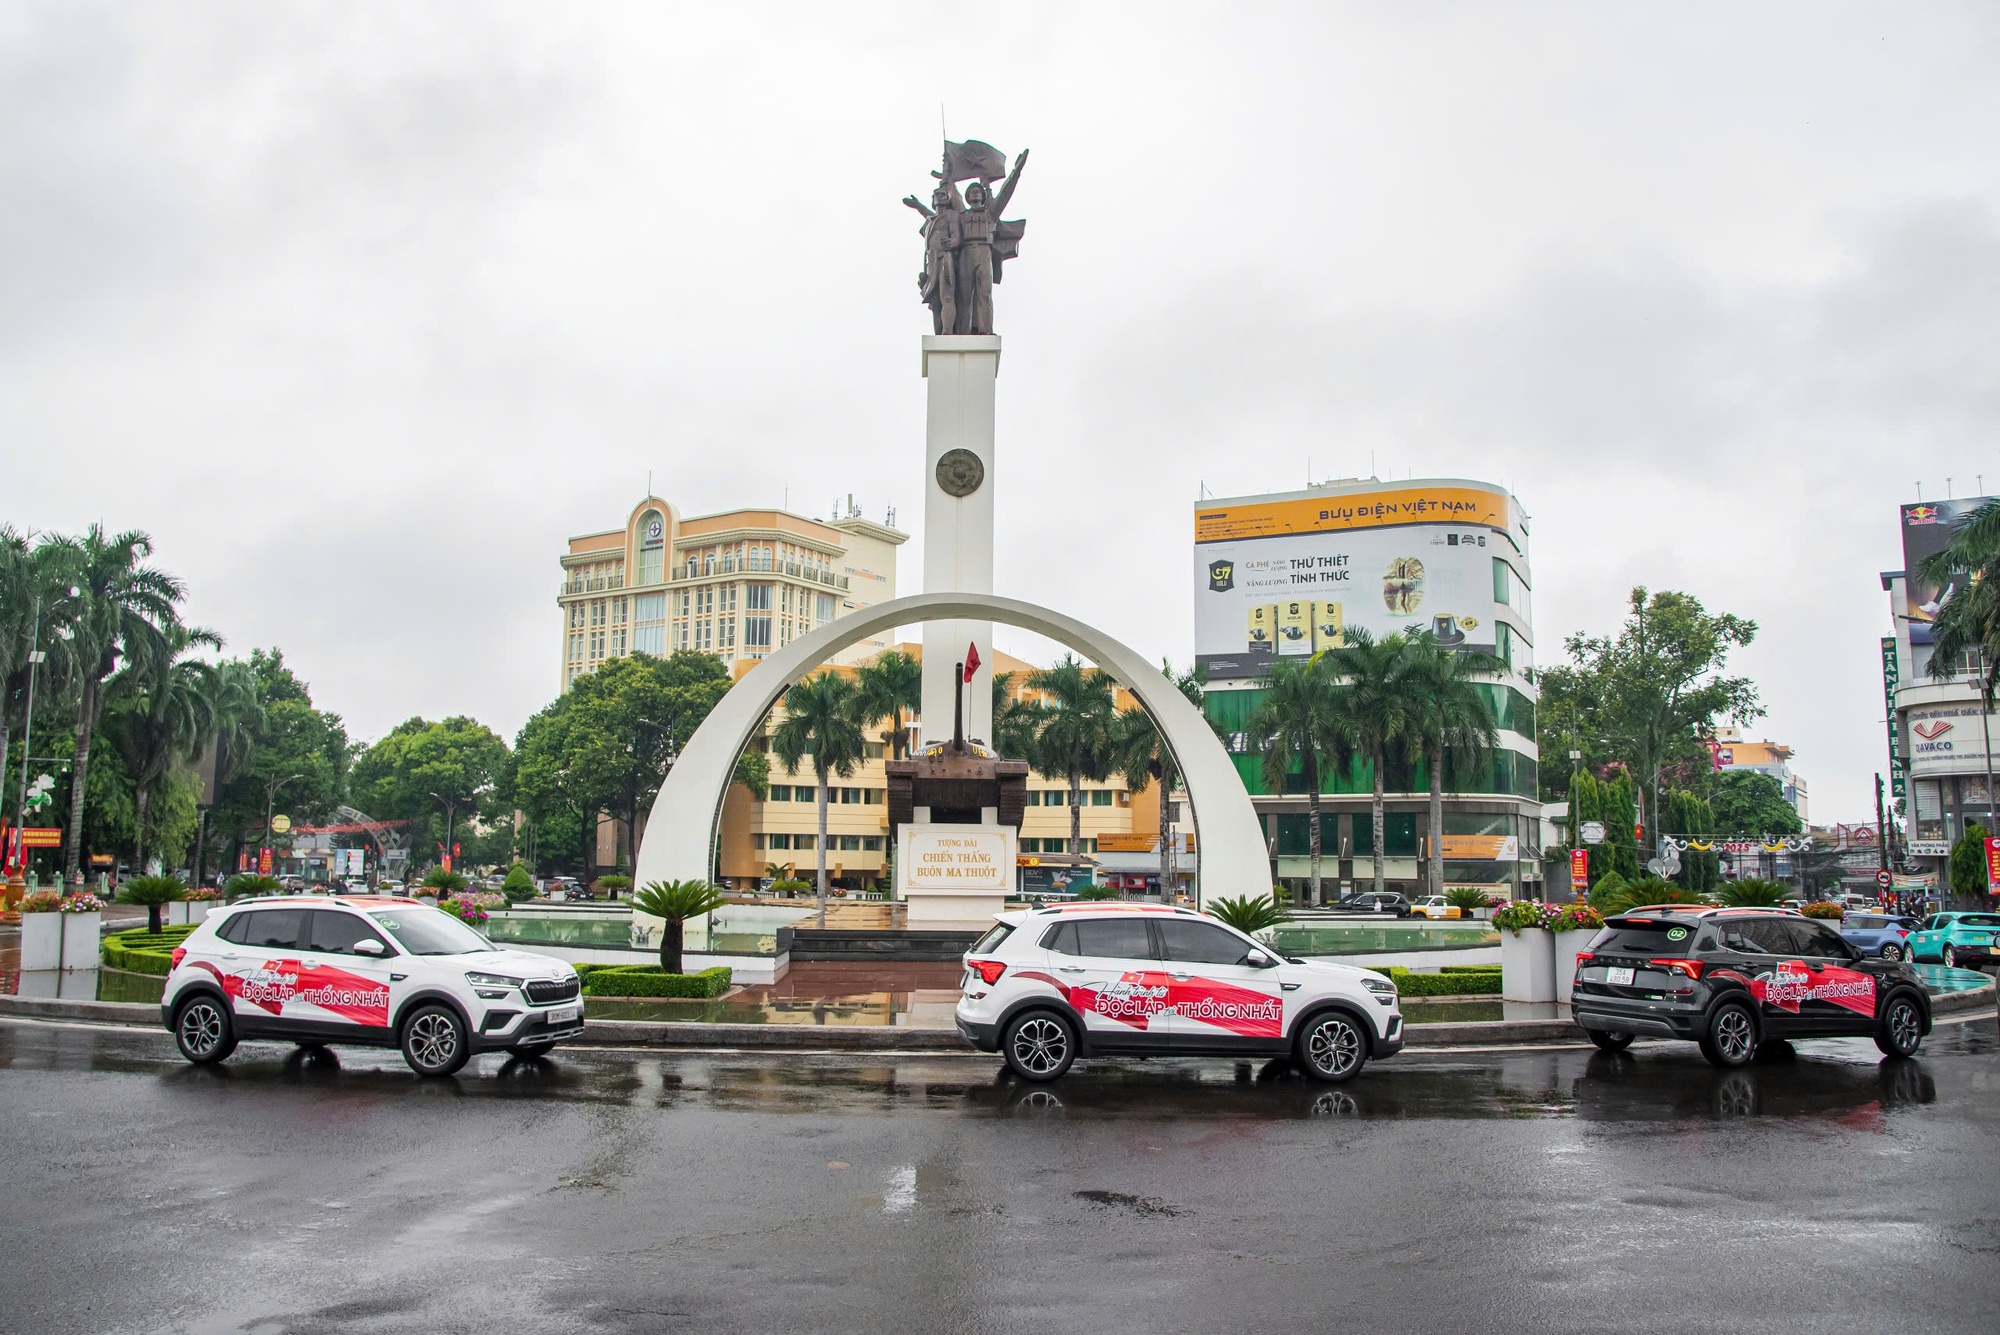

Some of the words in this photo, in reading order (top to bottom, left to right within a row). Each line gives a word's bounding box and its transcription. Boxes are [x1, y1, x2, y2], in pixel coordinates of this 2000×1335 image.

[1320, 508, 1353, 519] BƯU
[1358, 502, 1397, 518] ĐIỆN
[1402, 499, 1438, 514] VIỆT
[1442, 501, 1476, 512] NAM
[1290, 556, 1315, 569] THỨ
[1317, 554, 1349, 567] THIỆT
[1212, 566, 1231, 580] G7
[1319, 569, 1349, 581] THỨC
[937, 839, 961, 848] TƯỢNG
[964, 838, 977, 847] ĐÀI
[1724, 843, 1750, 852] 2025
[923, 850, 953, 862] CHIẾN
[957, 850, 991, 862] THẮNG
[917, 865, 942, 877] BUÔN
[946, 868, 962, 877] MA
[965, 865, 997, 879] THUỘT
[1670, 930, 1683, 938] 02
[242, 984, 271, 1003] ĐỘC
[273, 985, 295, 1004] LẬP
[305, 985, 351, 1005] THỐNG
[353, 986, 389, 1007] NHẤT
[1132, 985, 1155, 996] trình
[1790, 984, 1808, 1003] LẬP
[1815, 980, 1849, 998] THỐNG
[1850, 978, 1874, 996] NHẤT
[1096, 998, 1134, 1016] ĐỘC
[1136, 998, 1165, 1018] LẬP
[1179, 999, 1237, 1018] THỐNG
[1239, 1000, 1282, 1020] NHẤT
